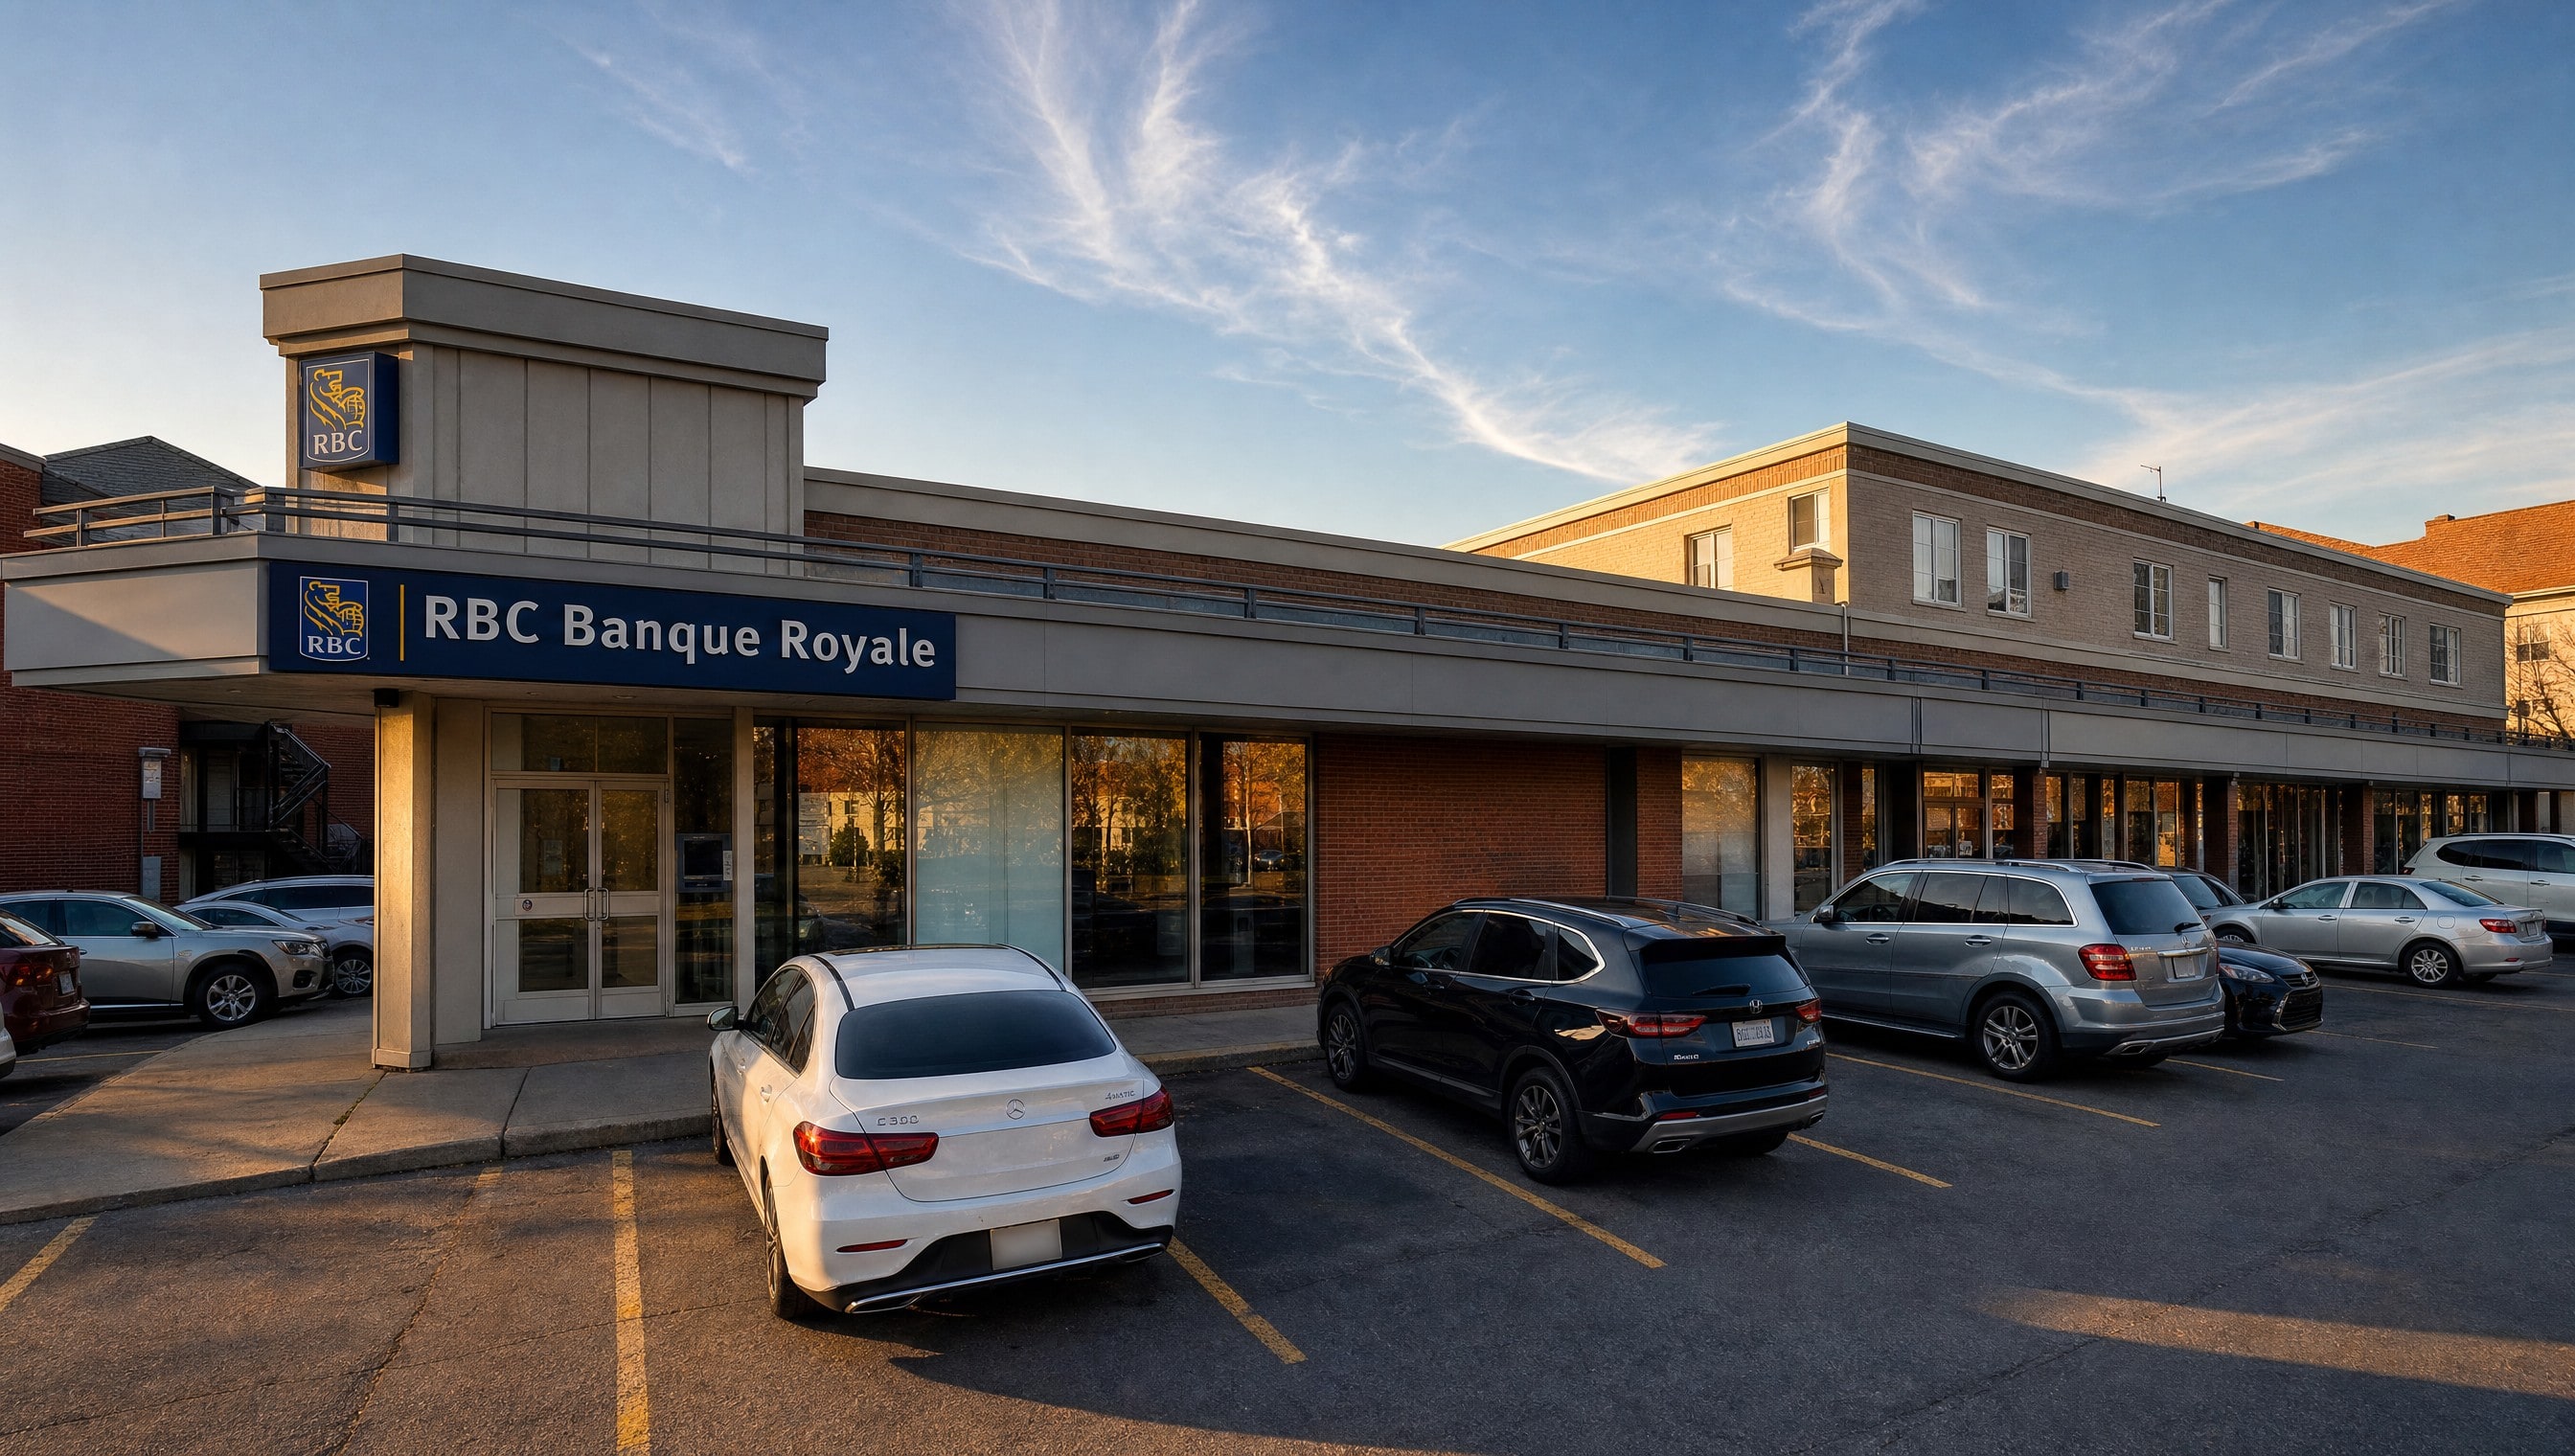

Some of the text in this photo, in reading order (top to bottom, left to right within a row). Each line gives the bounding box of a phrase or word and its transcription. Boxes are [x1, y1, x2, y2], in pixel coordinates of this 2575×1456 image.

[312, 429, 363, 455] RBC
[307, 635, 361, 655] RBC
[425, 595, 936, 674] RBC Banque Royale
